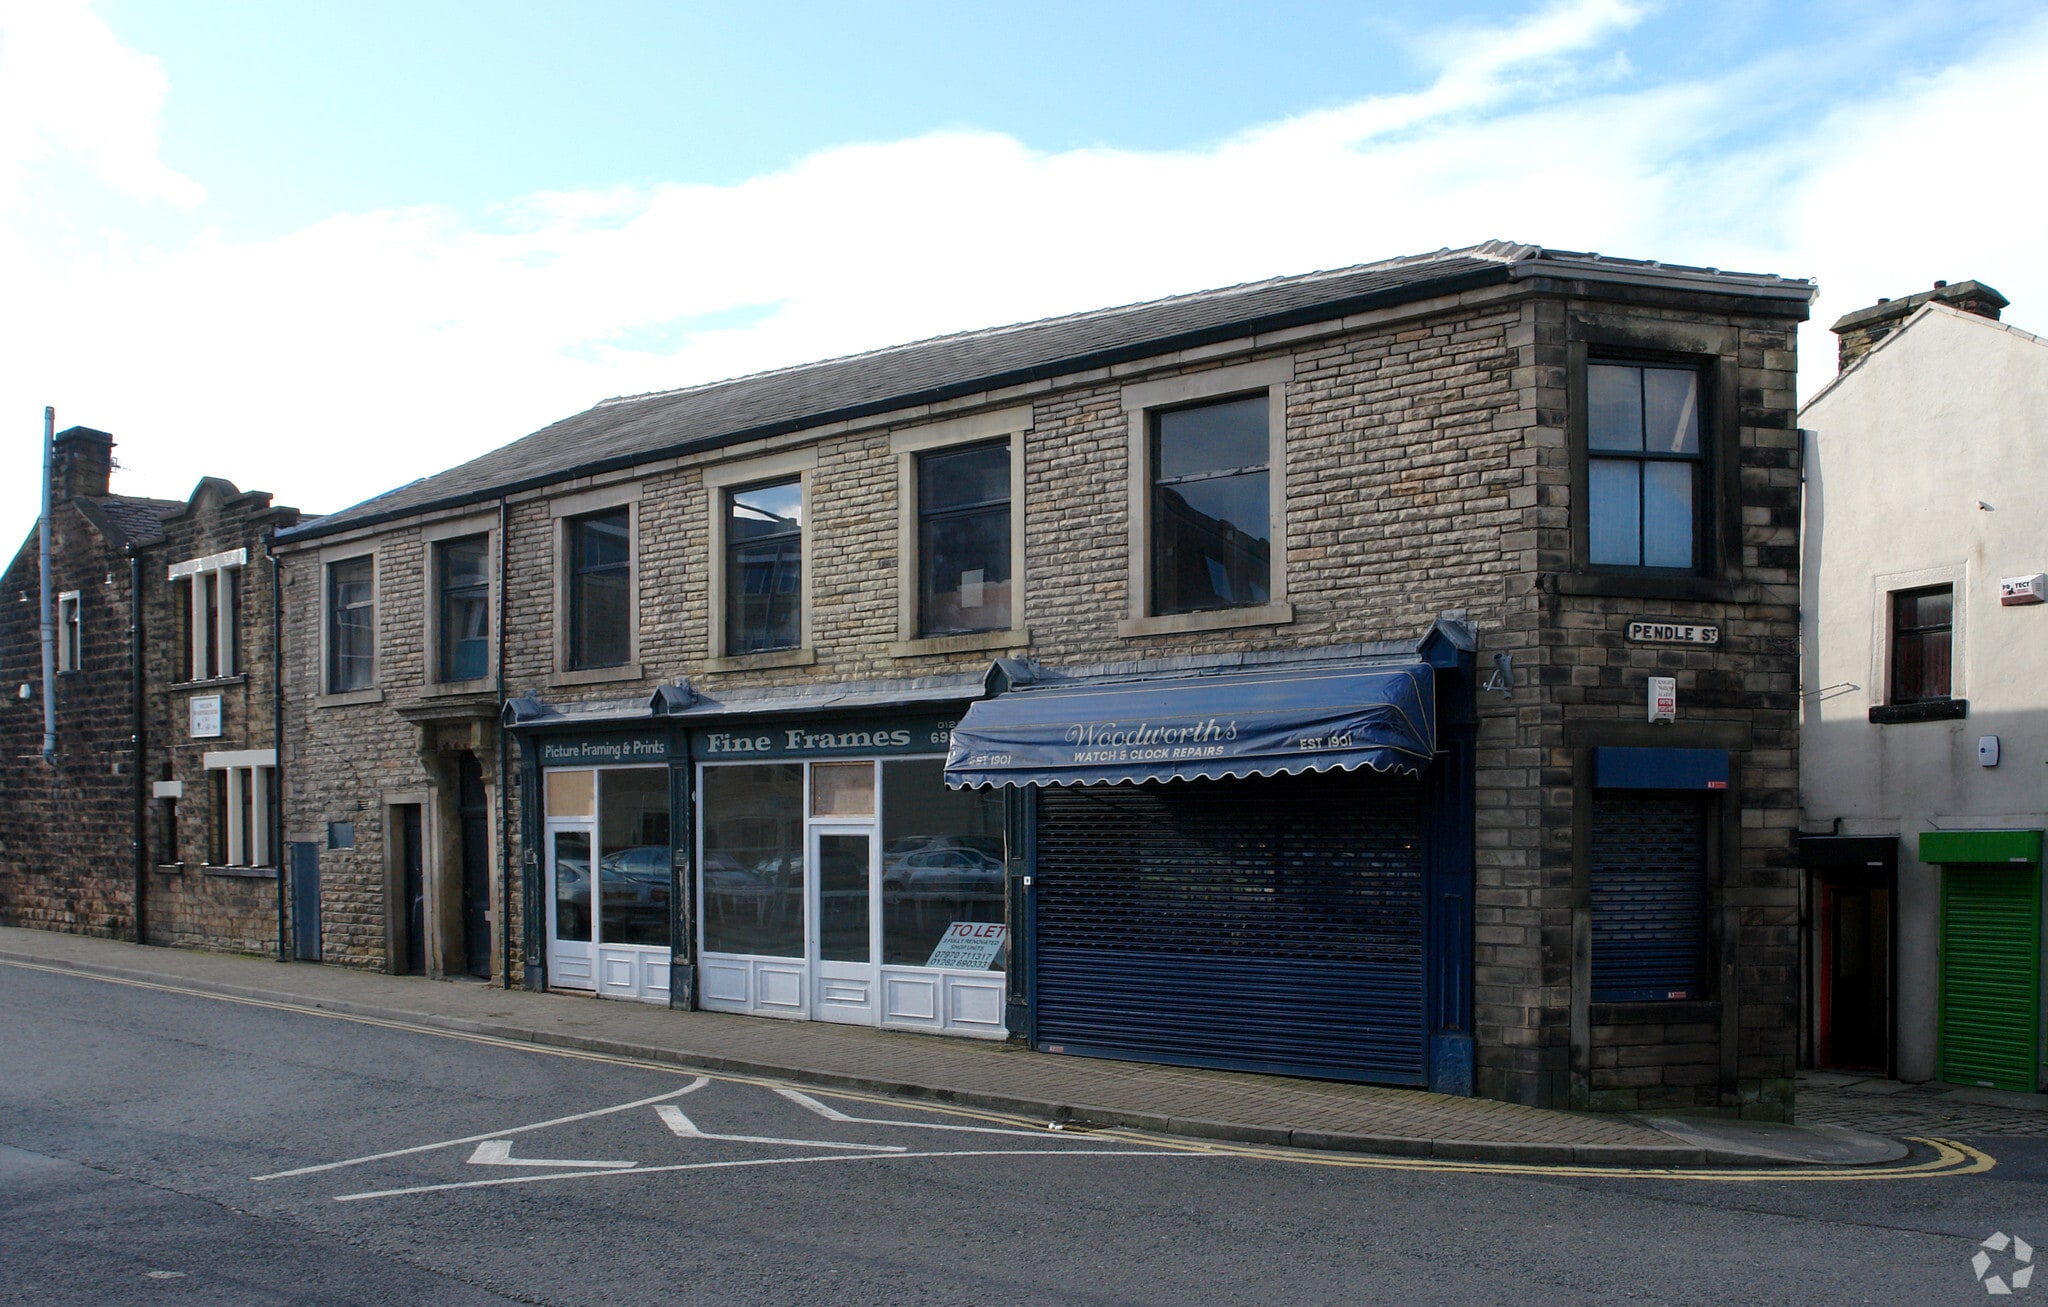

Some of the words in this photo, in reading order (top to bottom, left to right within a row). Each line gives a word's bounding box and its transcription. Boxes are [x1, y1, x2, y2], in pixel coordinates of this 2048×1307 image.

[1633, 625, 1694, 641] PENDLE
[1064, 718, 1237, 747] Woodworths
[707, 733, 771, 753] Fine
[785, 729, 911, 750] Frames
[1300, 737, 1323, 750] EST
[1328, 734, 1353, 748] 1901
[545, 744, 580, 758] Picture
[581, 742, 620, 760] Framing
[622, 742, 631, 755] &
[633, 740, 665, 755] Prints
[1074, 750, 1116, 763] WATCH
[1119, 750, 1127, 760] &
[1129, 748, 1169, 760] CLOCK
[1172, 745, 1225, 758] REPAIRS
[991, 754, 1012, 765] 1901
[950, 924, 973, 937] TO
[973, 925, 1006, 938] LET
[965, 938, 1000, 946] RENOVATED
[930, 959, 956, 967] 01282
[956, 960, 988, 968] 690333
[934, 951, 960, 959] 07970
[960, 952, 992, 961] 711317
